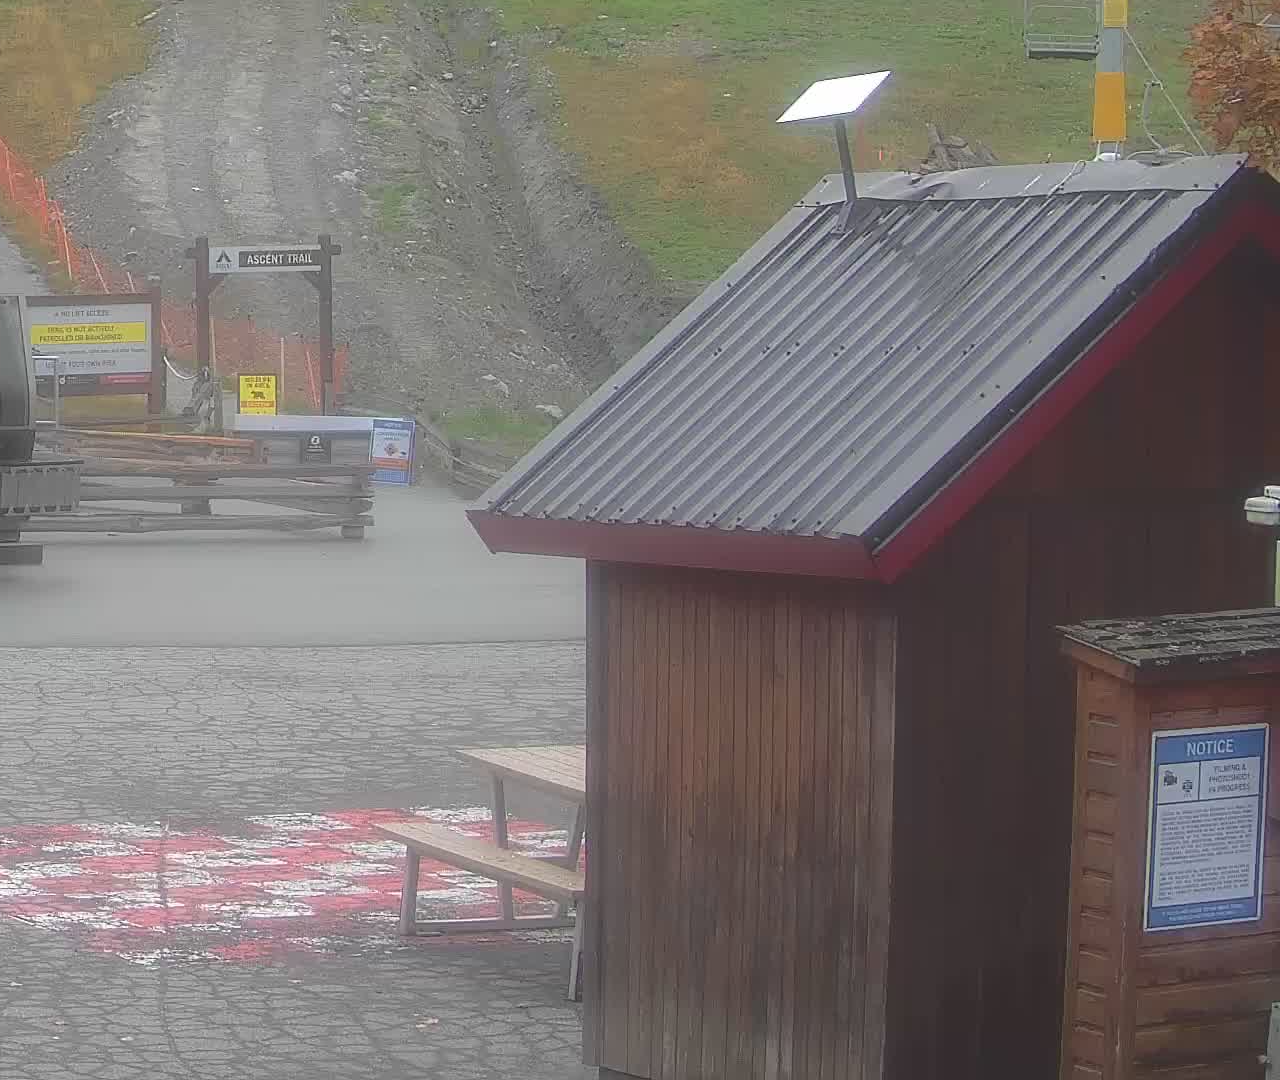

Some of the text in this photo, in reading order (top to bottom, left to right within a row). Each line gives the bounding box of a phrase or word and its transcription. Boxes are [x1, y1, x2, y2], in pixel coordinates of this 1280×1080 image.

[247, 253, 312, 264] ASCENT TRAIL
[1187, 739, 1234, 756] NOTICE
